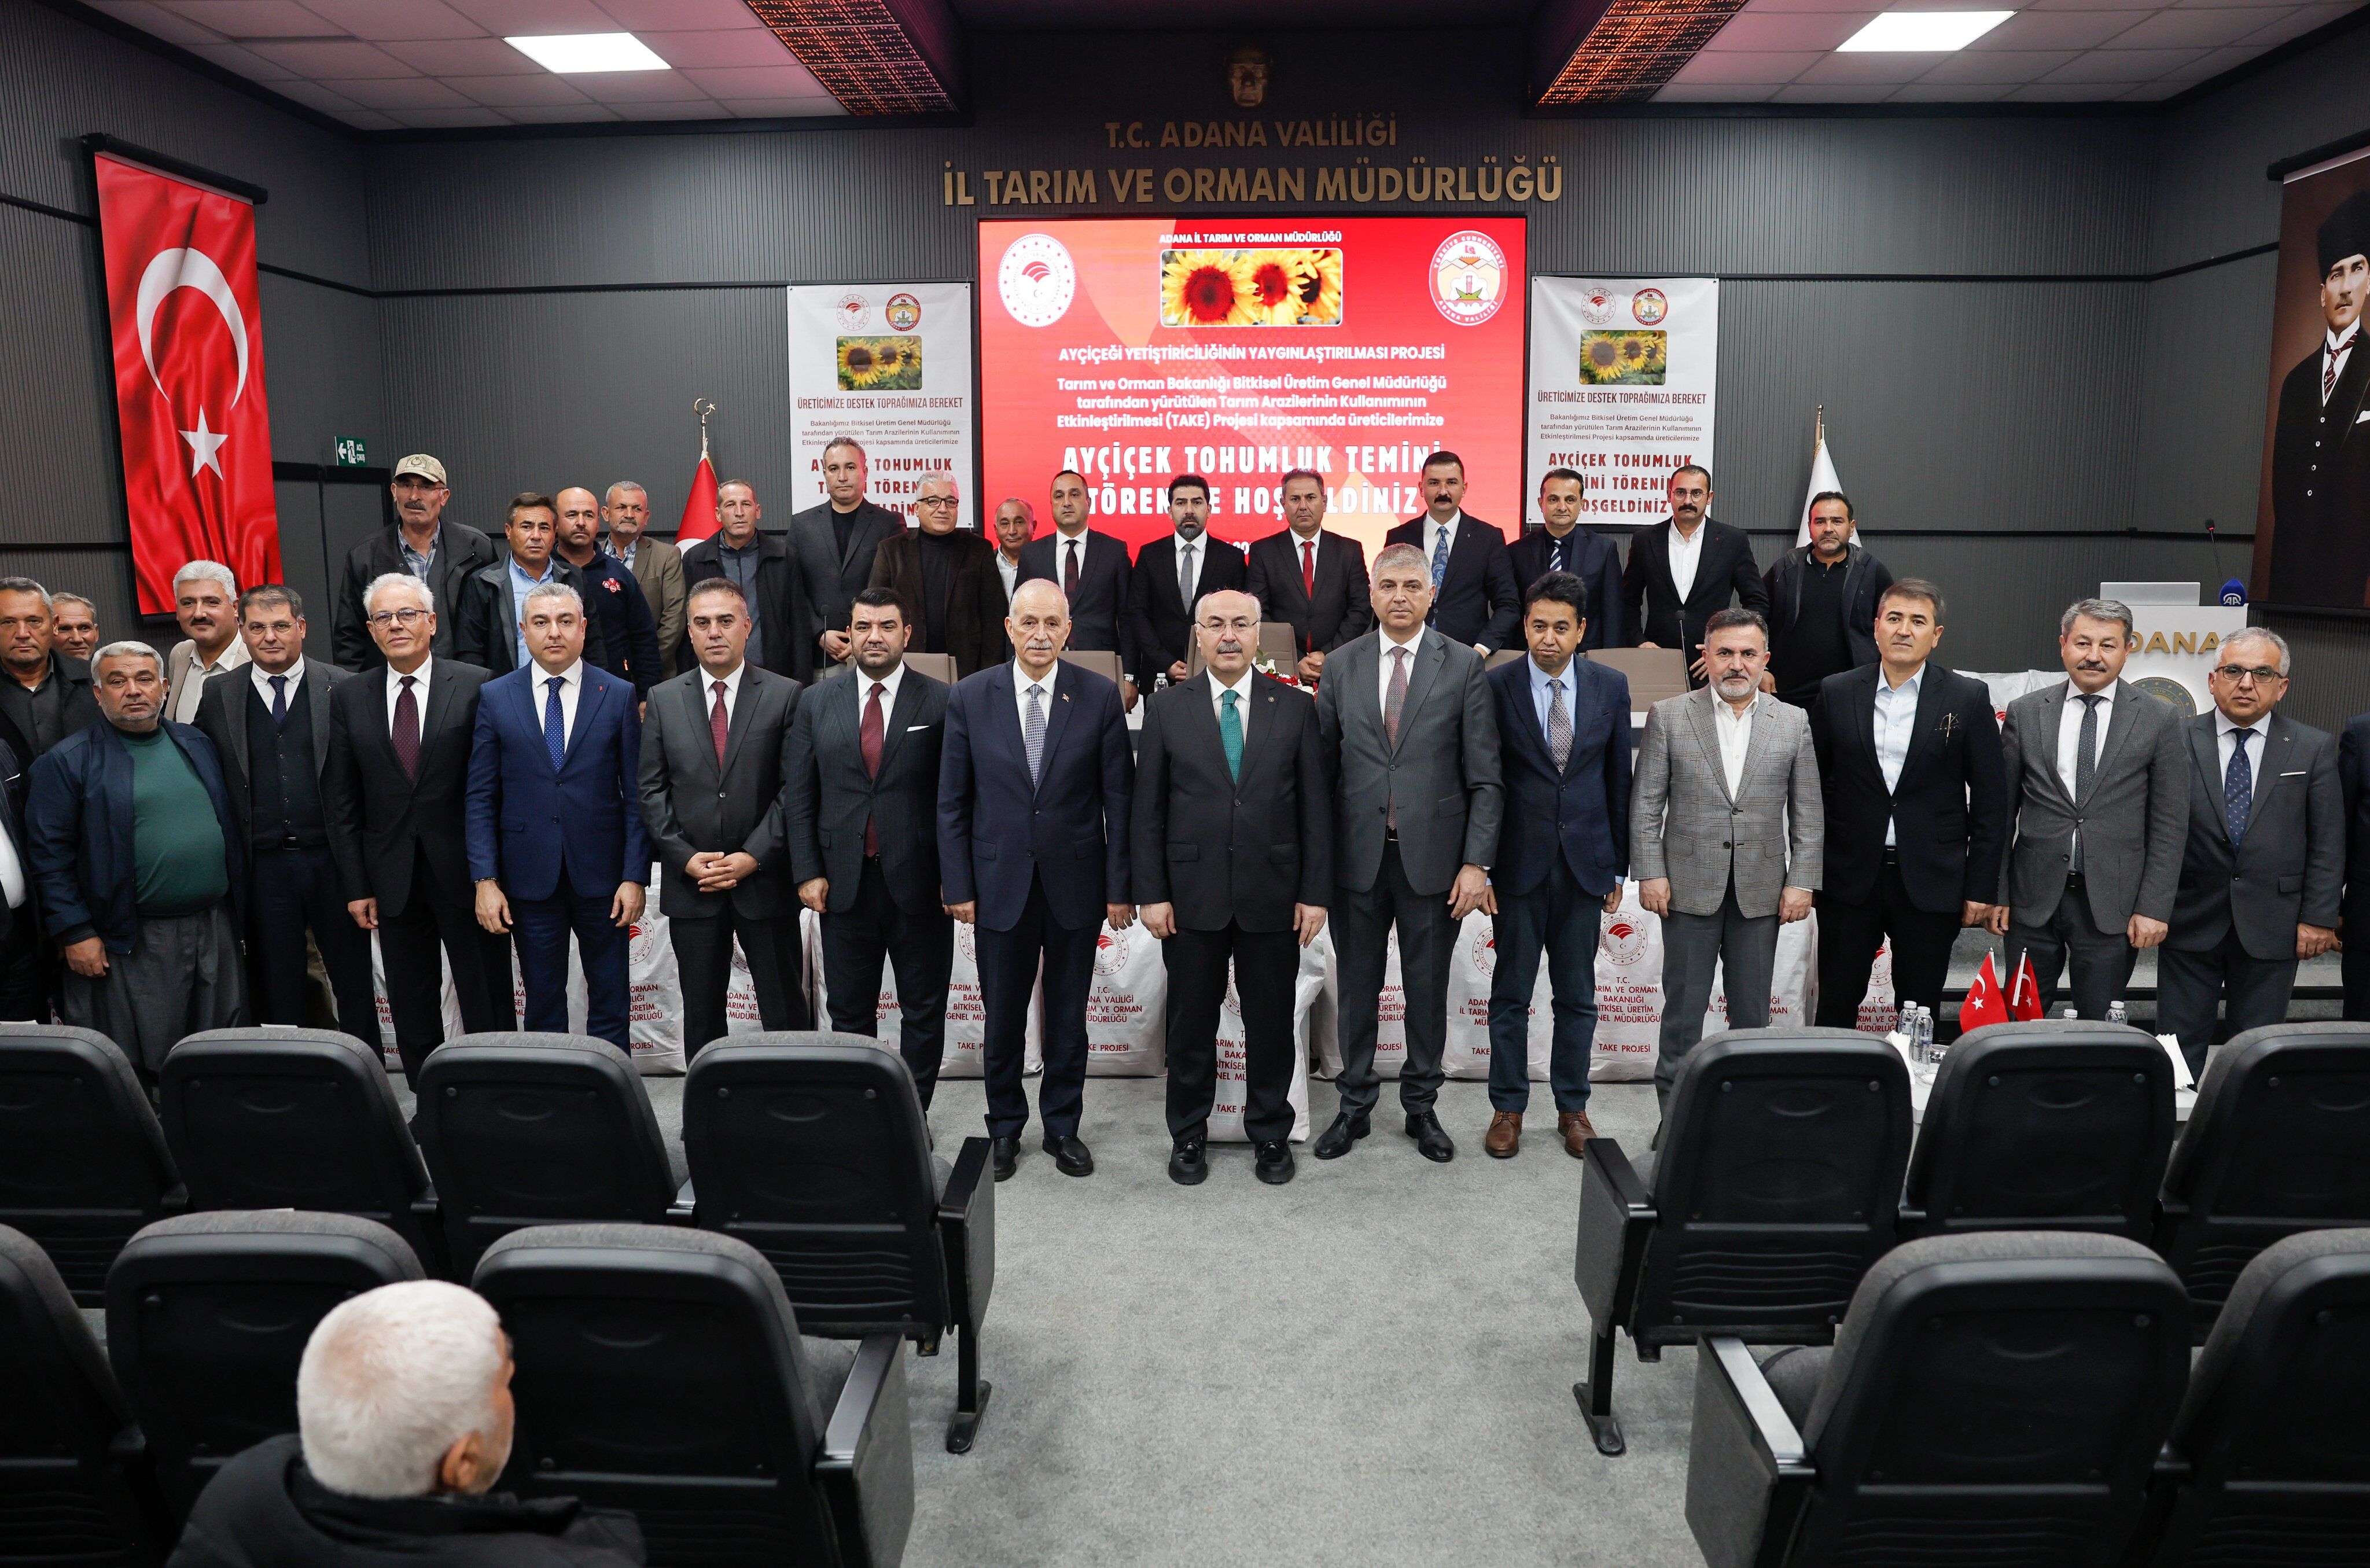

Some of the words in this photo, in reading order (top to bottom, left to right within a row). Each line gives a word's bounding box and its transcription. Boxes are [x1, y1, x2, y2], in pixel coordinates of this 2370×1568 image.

[1106, 122, 1151, 148] T.C.
[1160, 121, 1267, 147] ADANA
[1275, 112, 1396, 147] VALİLİĞİ
[944, 161, 974, 205] İL
[984, 170, 1097, 205] TARIM
[1108, 169, 1153, 203] VE
[1164, 167, 1304, 203] ORMAN
[1315, 155, 1562, 202] MÜDÜRLÜĞÜ
[1159, 234, 1193, 243] ADANA
[1194, 231, 1202, 243] İL
[1203, 234, 1232, 243] TARIM
[1234, 234, 1246, 242] VE
[1247, 233, 1282, 242] ORMAN
[1284, 231, 1342, 242] MÜDÜRLÜĞÜ
[1059, 344, 1122, 365] AYÇİÇEĞİ
[1125, 344, 1245, 364] YETİŞTİRİCİLİĞİNİN
[1249, 346, 1388, 363] YAYGINLAŞTIRILMASI
[1391, 343, 1444, 359] PROJESİ
[1057, 378, 1096, 391] Tarım
[1099, 380, 1116, 390] ve
[1118, 377, 1164, 390] Orman
[1167, 376, 1230, 393] Bakanlığı
[1233, 376, 1282, 389] Bitkisel
[1284, 373, 1329, 389] Üretim
[1332, 376, 1370, 389] Genel
[1373, 376, 1447, 392] Müdürlüğü
[798, 396, 845, 408] ÜRETİCİMİZE
[847, 399, 874, 408] DESTEK
[877, 396, 927, 408] TOPRAĞIMIZA
[929, 397, 963, 408] BEREKET
[1077, 395, 1149, 408] tarafından
[1151, 395, 1216, 412] yürütülen
[1219, 395, 1259, 408] Tarım
[1261, 393, 1337, 407] Arazilerinin
[1340, 394, 1426, 407] Kullanımının
[1538, 390, 1585, 403] ÜRETİCİMİZE
[1588, 392, 1617, 403] DESTEK
[1619, 391, 1670, 404] TOPRAĞIMIZA
[1672, 393, 1706, 404] BEREKET
[1057, 413, 1162, 431] Etkinleştirilmesi
[1166, 411, 1210, 430] (TAKE)
[1213, 413, 1257, 429] Projesi
[1260, 413, 1345, 430] kapsamında
[1348, 413, 1444, 426] üreticilerimize
[875, 458, 952, 471] TOHUMLUK
[1062, 441, 1172, 480] AYÇİÇEK
[1185, 446, 1332, 473] TOHUMLUK
[1549, 451, 1606, 469] AYÇİÇEK
[1614, 454, 1692, 468] TOHUMLUK
[1235, 481, 1417, 521] HOŞLDİNİZ
[1583, 498, 1667, 515] OŞGELDİNİZ
[2130, 631, 2220, 654] DANA
[1105, 995, 1134, 1003] VALİLİĞİ
[1604, 995, 1644, 1003] BAKANLIĞI
[954, 1002, 982, 1011] BİTKİSEL
[1460, 1006, 1465, 1014] İL
[1627, 1004, 1654, 1013] ÜRETİM
[1709, 1003, 1714, 1012] İL
[630, 1010, 663, 1021] DÜRLÜĞÜ
[946, 1013, 969, 1021] GENEL
[1086, 1013, 1127, 1023] ÜDÜRLÜĞÜ
[1614, 1013, 1660, 1023] MÜDÜRLÜĞÜ
[631, 1040, 653, 1050] ROJESİ
[1101, 1043, 1128, 1051] PROJESİ
[1215, 1039, 1234, 1048] ARIM
[1377, 1042, 1401, 1051] ROJESİ
[1622, 1044, 1650, 1052] PROJESİ
[1217, 1104, 1236, 1113] TAKE
